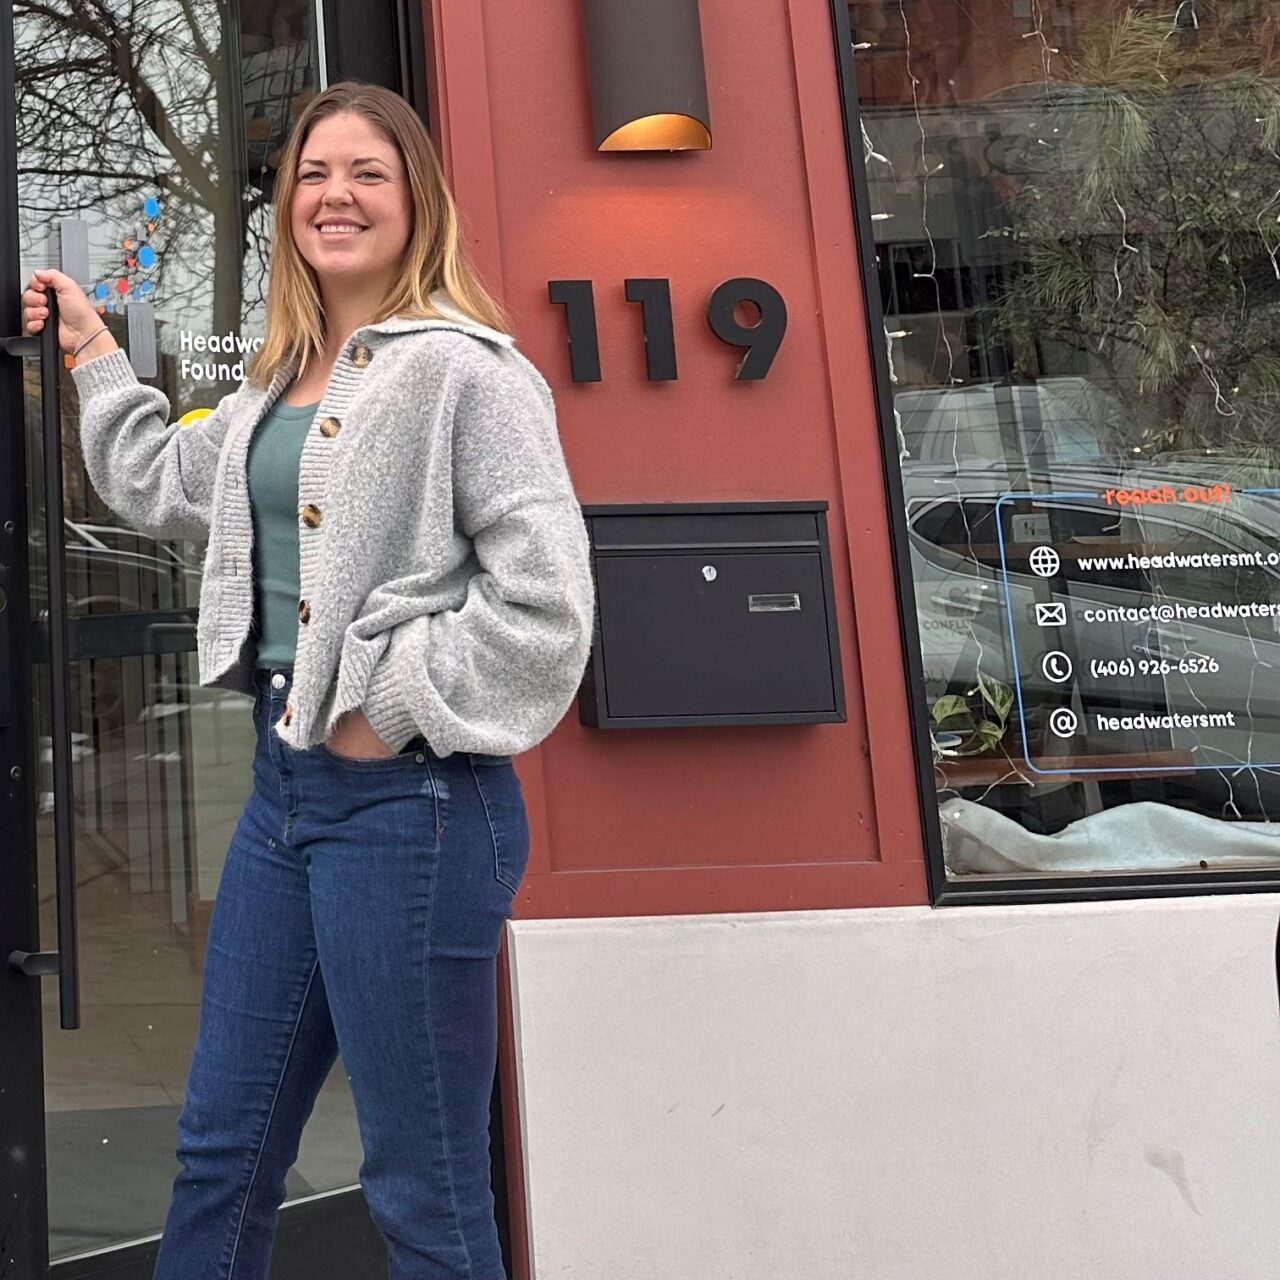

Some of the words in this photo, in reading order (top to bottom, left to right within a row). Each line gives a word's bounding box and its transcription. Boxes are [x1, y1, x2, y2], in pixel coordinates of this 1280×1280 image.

[547, 277, 789, 382] 119
[181, 359, 245, 381] Found
[1105, 483, 1177, 505] reach
[1183, 481, 1231, 504] out!
[1078, 550, 1280, 571] www.headwatersmt.o
[1090, 657, 1135, 679] (406)
[1138, 657, 1220, 675] 926-6526
[1097, 711, 1236, 731] headwatersmt
